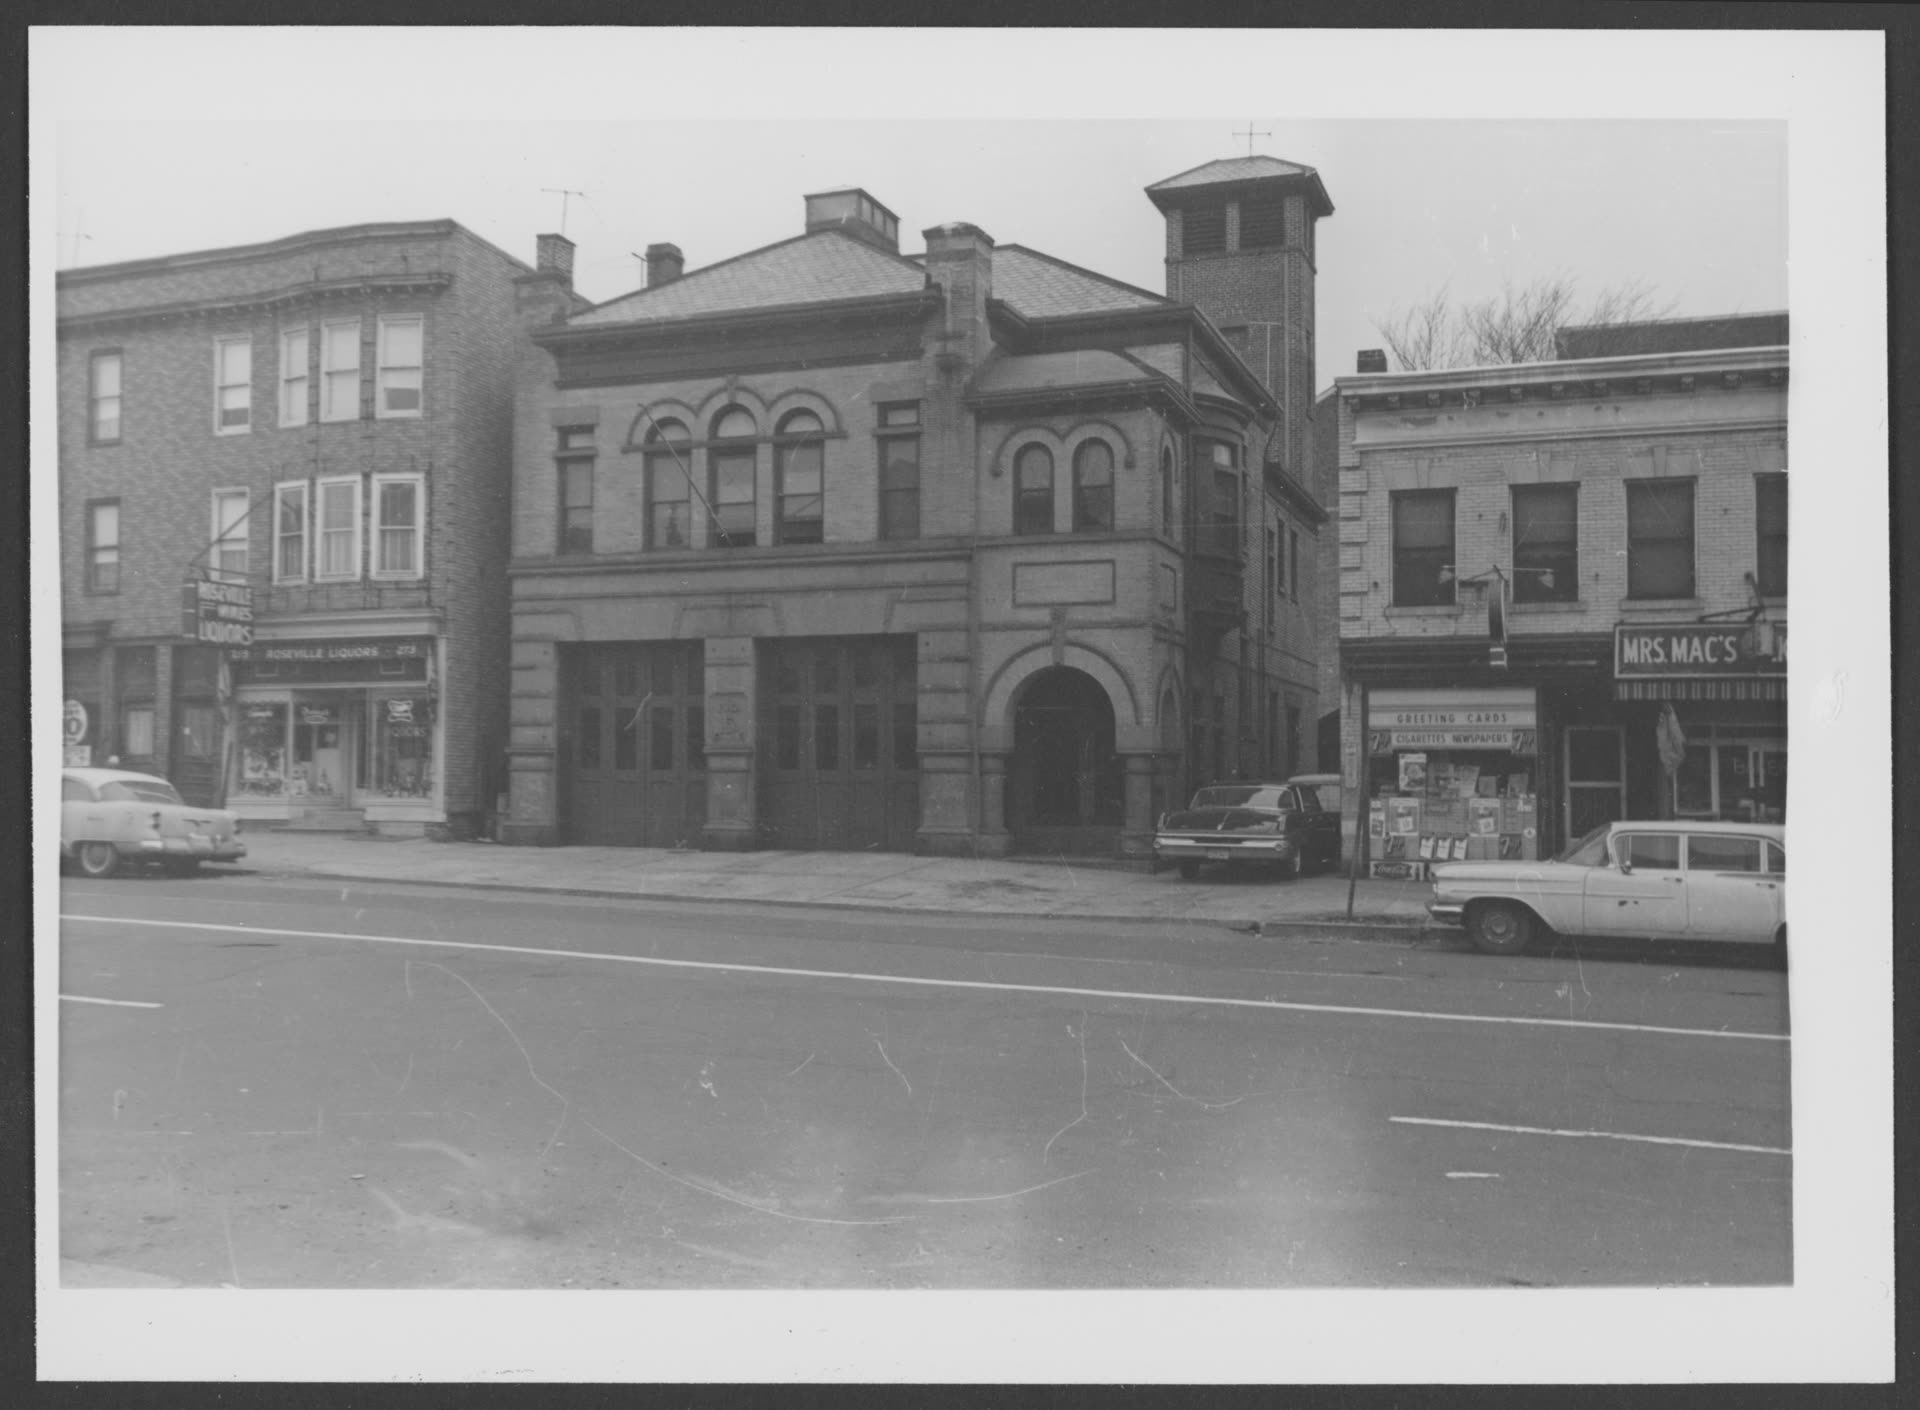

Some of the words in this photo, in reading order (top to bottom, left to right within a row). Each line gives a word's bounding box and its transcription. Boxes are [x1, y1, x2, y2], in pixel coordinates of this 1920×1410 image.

[265, 648, 323, 659] ROSEVILLE
[328, 646, 379, 658] LIQUORS
[1623, 636, 1668, 664] MRS.
[1671, 635, 1737, 664] MAC'S
[1397, 713, 1456, 724] GREETING
[1467, 712, 1508, 723] CARDS
[1395, 733, 1446, 745] CIGARETTES
[1452, 733, 1508, 744] NEWSPAPERS
